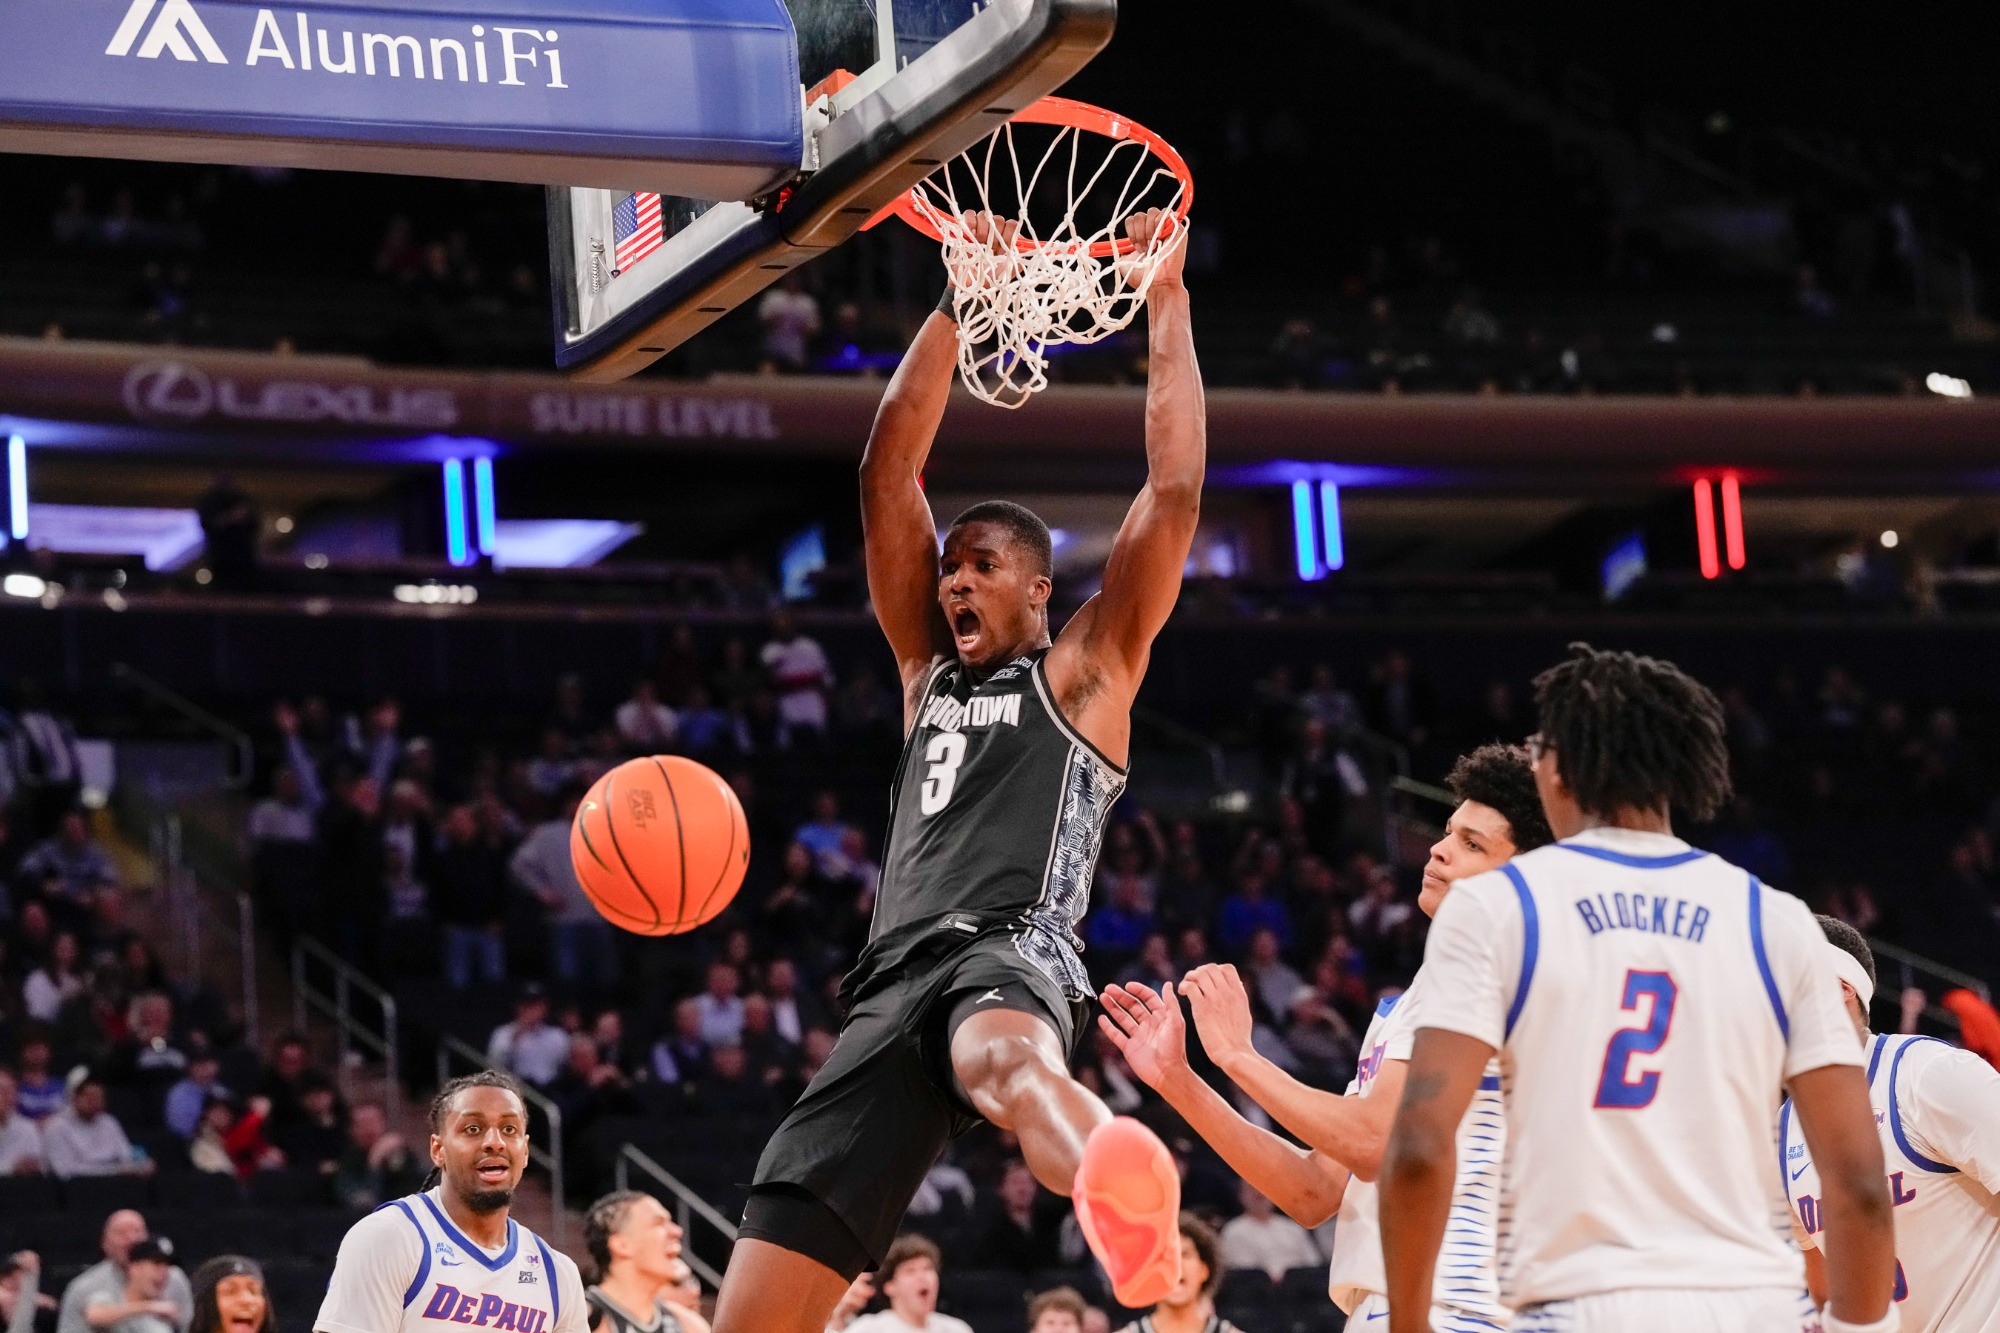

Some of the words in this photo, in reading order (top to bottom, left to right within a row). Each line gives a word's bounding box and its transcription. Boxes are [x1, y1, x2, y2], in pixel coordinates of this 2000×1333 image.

[246, 9, 568, 89] AlumniFi
[216, 381, 458, 427] LEXUS
[529, 393, 648, 433] SUITE
[657, 396, 779, 440] LEVEL
[921, 732, 968, 816] 3
[1576, 892, 1711, 944] BLOCKER
[1592, 968, 1678, 1110] 2
[518, 1275, 538, 1284] EAST
